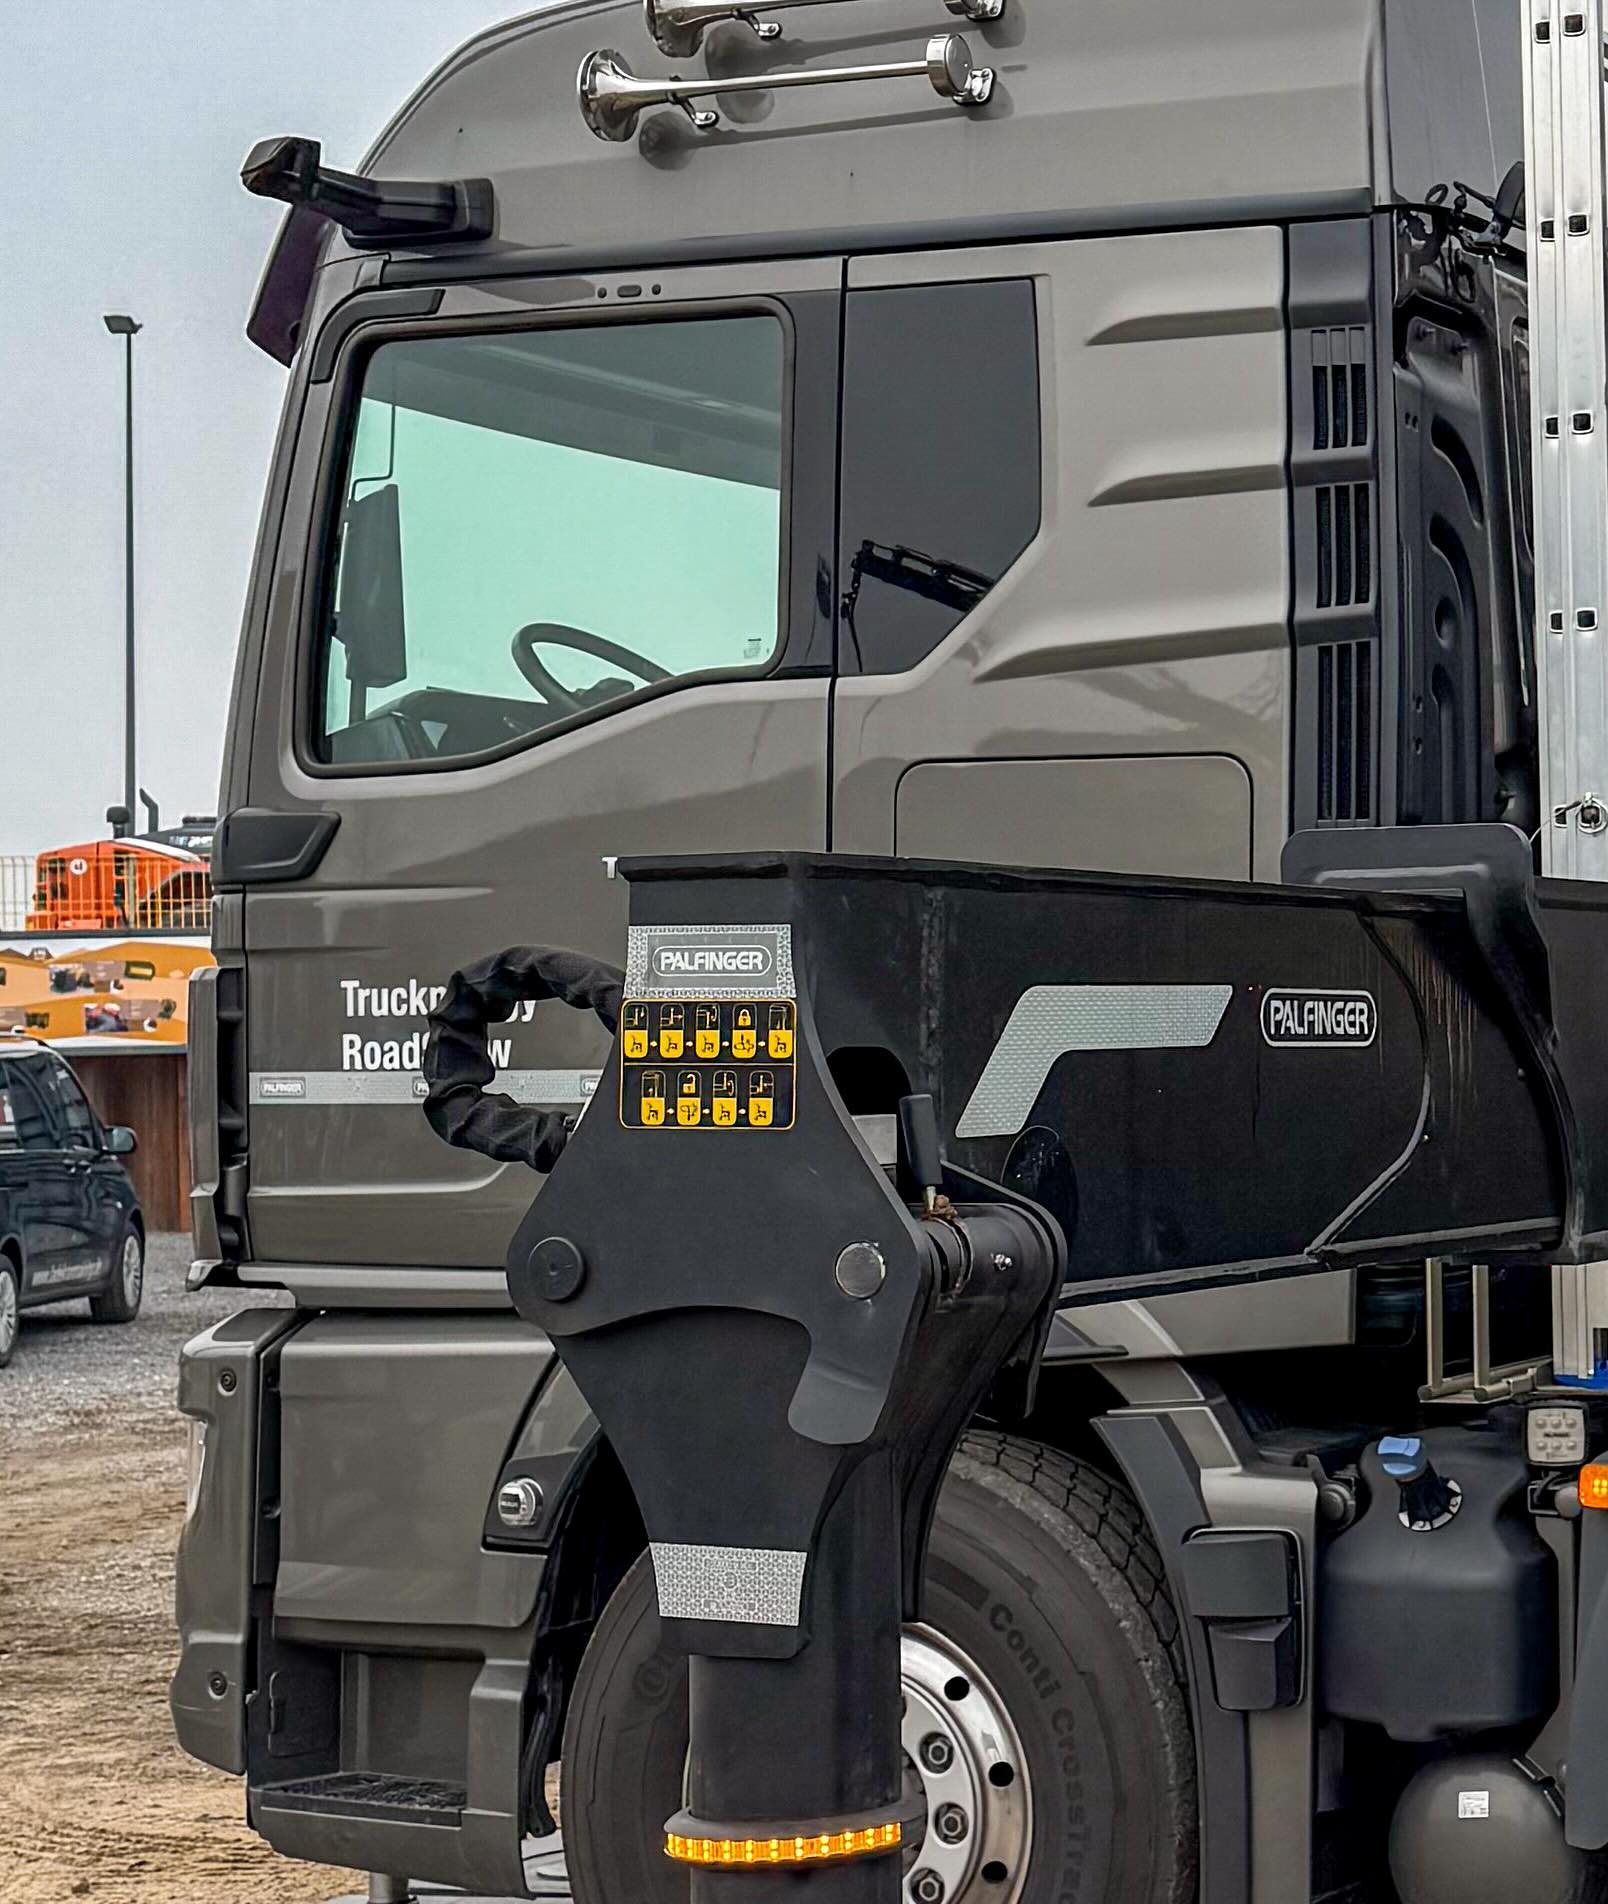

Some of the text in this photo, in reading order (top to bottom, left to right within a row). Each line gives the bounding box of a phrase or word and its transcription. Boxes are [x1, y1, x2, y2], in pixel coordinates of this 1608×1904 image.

[660, 951, 764, 972] PALFINGER
[1270, 999, 1369, 1035] PALFINGER
[989, 1602, 1063, 1701] Conti
